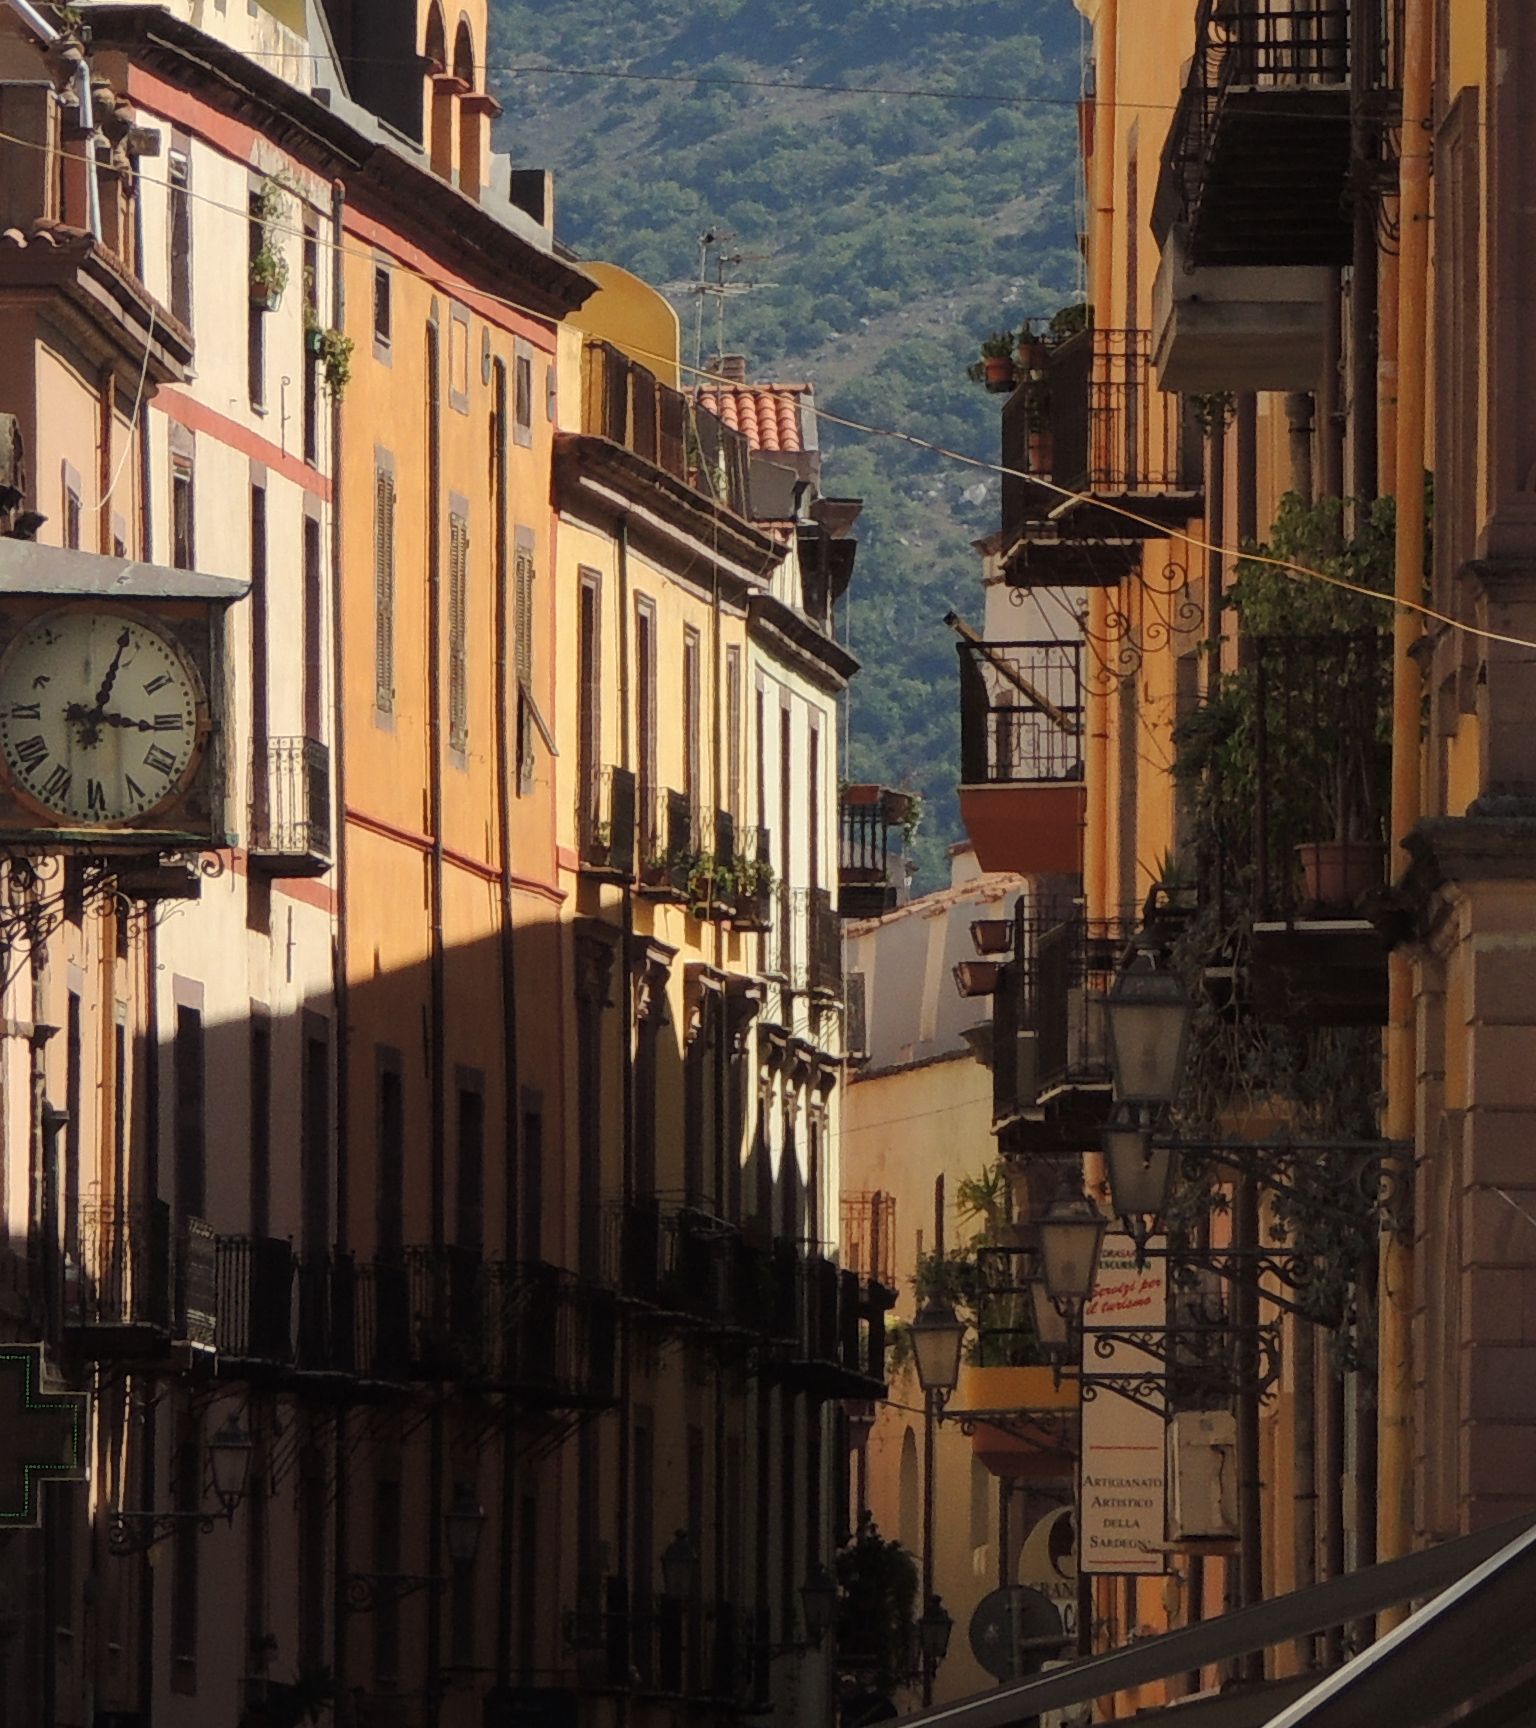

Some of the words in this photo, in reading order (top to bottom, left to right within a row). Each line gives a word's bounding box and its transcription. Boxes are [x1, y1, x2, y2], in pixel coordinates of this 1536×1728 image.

[1138, 1279, 1161, 1294] per
[1101, 1297, 1152, 1314] turismo
[1090, 1535, 1151, 1550] SARDEGN
